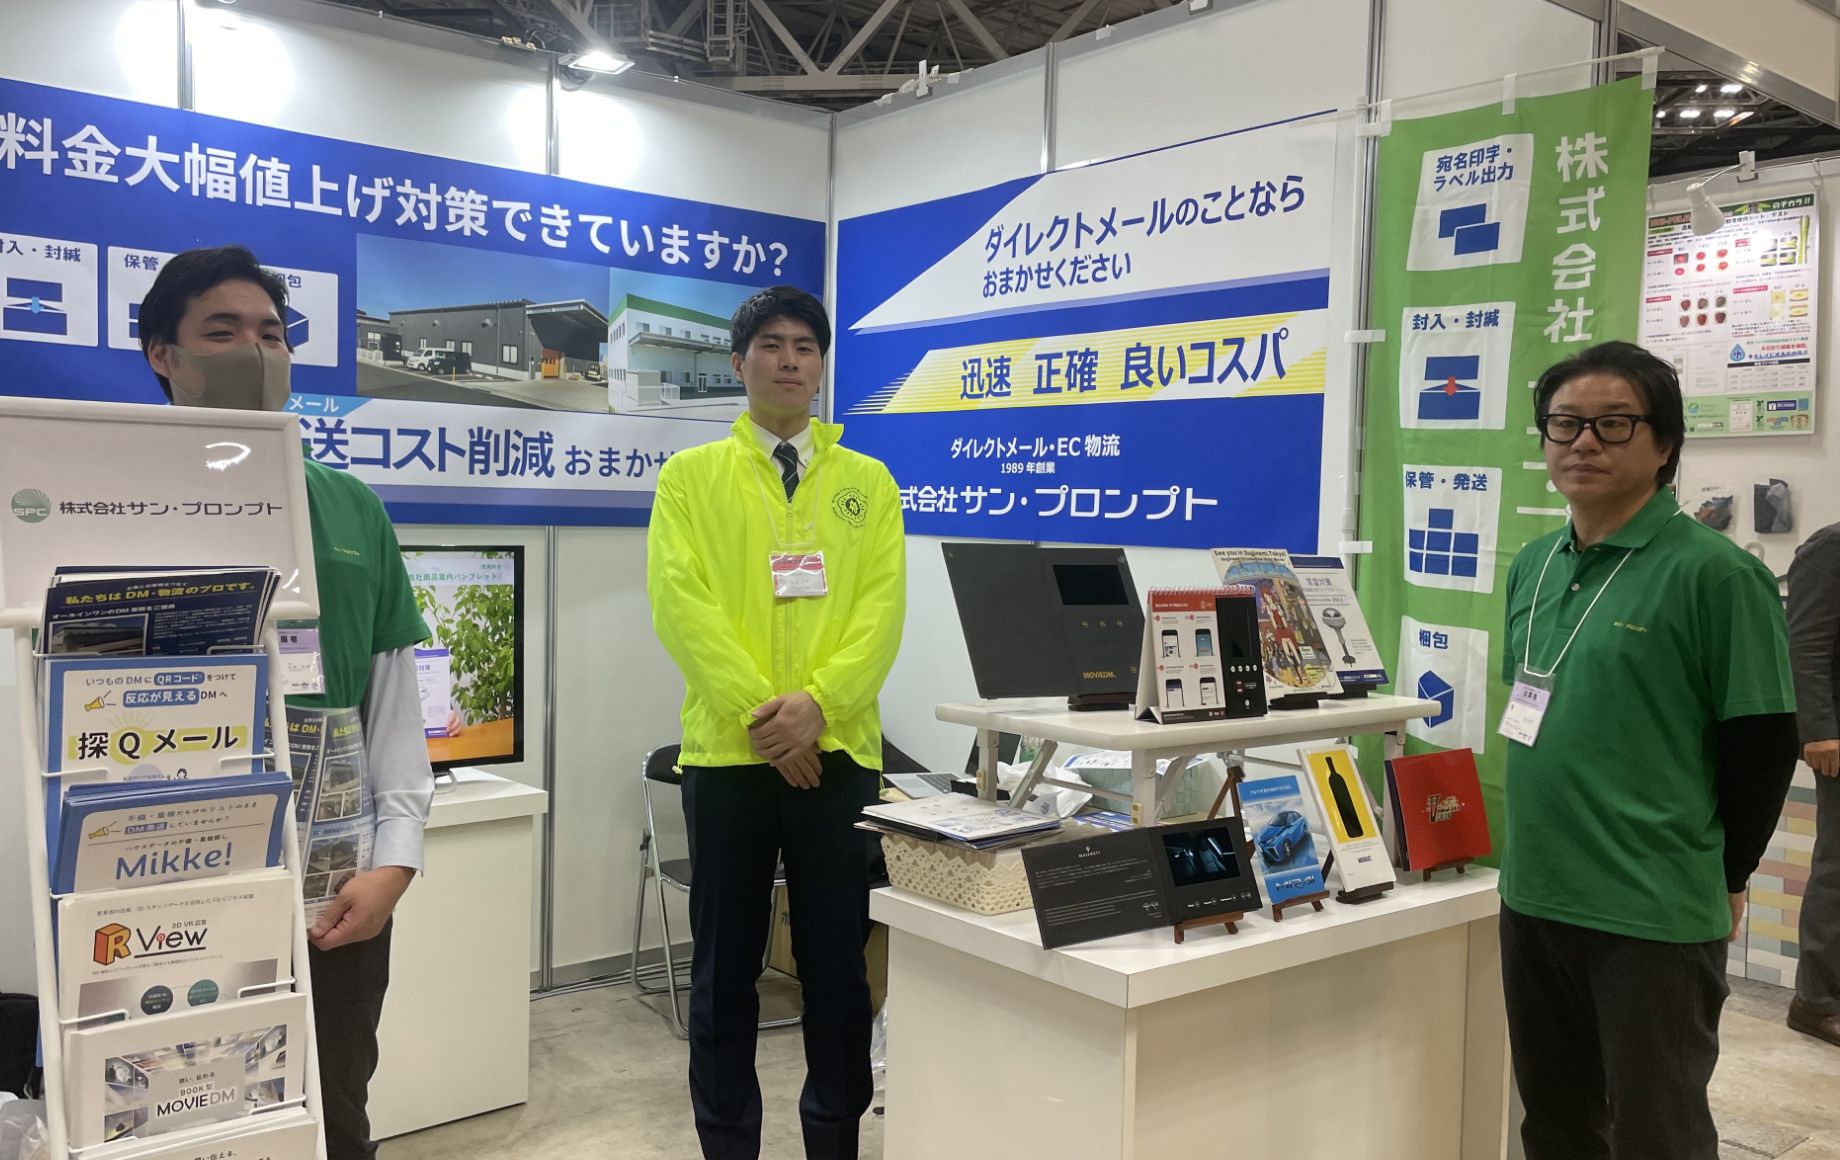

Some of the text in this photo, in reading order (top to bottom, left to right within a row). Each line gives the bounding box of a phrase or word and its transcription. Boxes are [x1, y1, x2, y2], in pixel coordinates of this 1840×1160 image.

[1433, 162, 1514, 192] ラベル出力
[0, 112, 789, 277] 料金大幅値上げ対策できていますか?
[985, 175, 1305, 263] ダイレクトメールのことなら
[1543, 132, 1609, 344] 株式会社
[982, 252, 1131, 298] おまかせください
[1412, 308, 1500, 331] 封入・封緘
[960, 326, 1290, 401] 迅速 正確 良いコスパ
[289, 395, 340, 413] メール
[1405, 470, 1488, 491] 保管・発送
[12, 506, 48, 517] SPC
[59, 500, 283, 517] 株式会社サン・プロンプト
[1419, 628, 1448, 650] 梱包
[125, 692, 197, 704] 反応が見える
[115, 841, 233, 881] Mikke!
[93, 922, 132, 967] R
[136, 925, 208, 952] View
[157, 1088, 236, 1117] MOVIEDM
